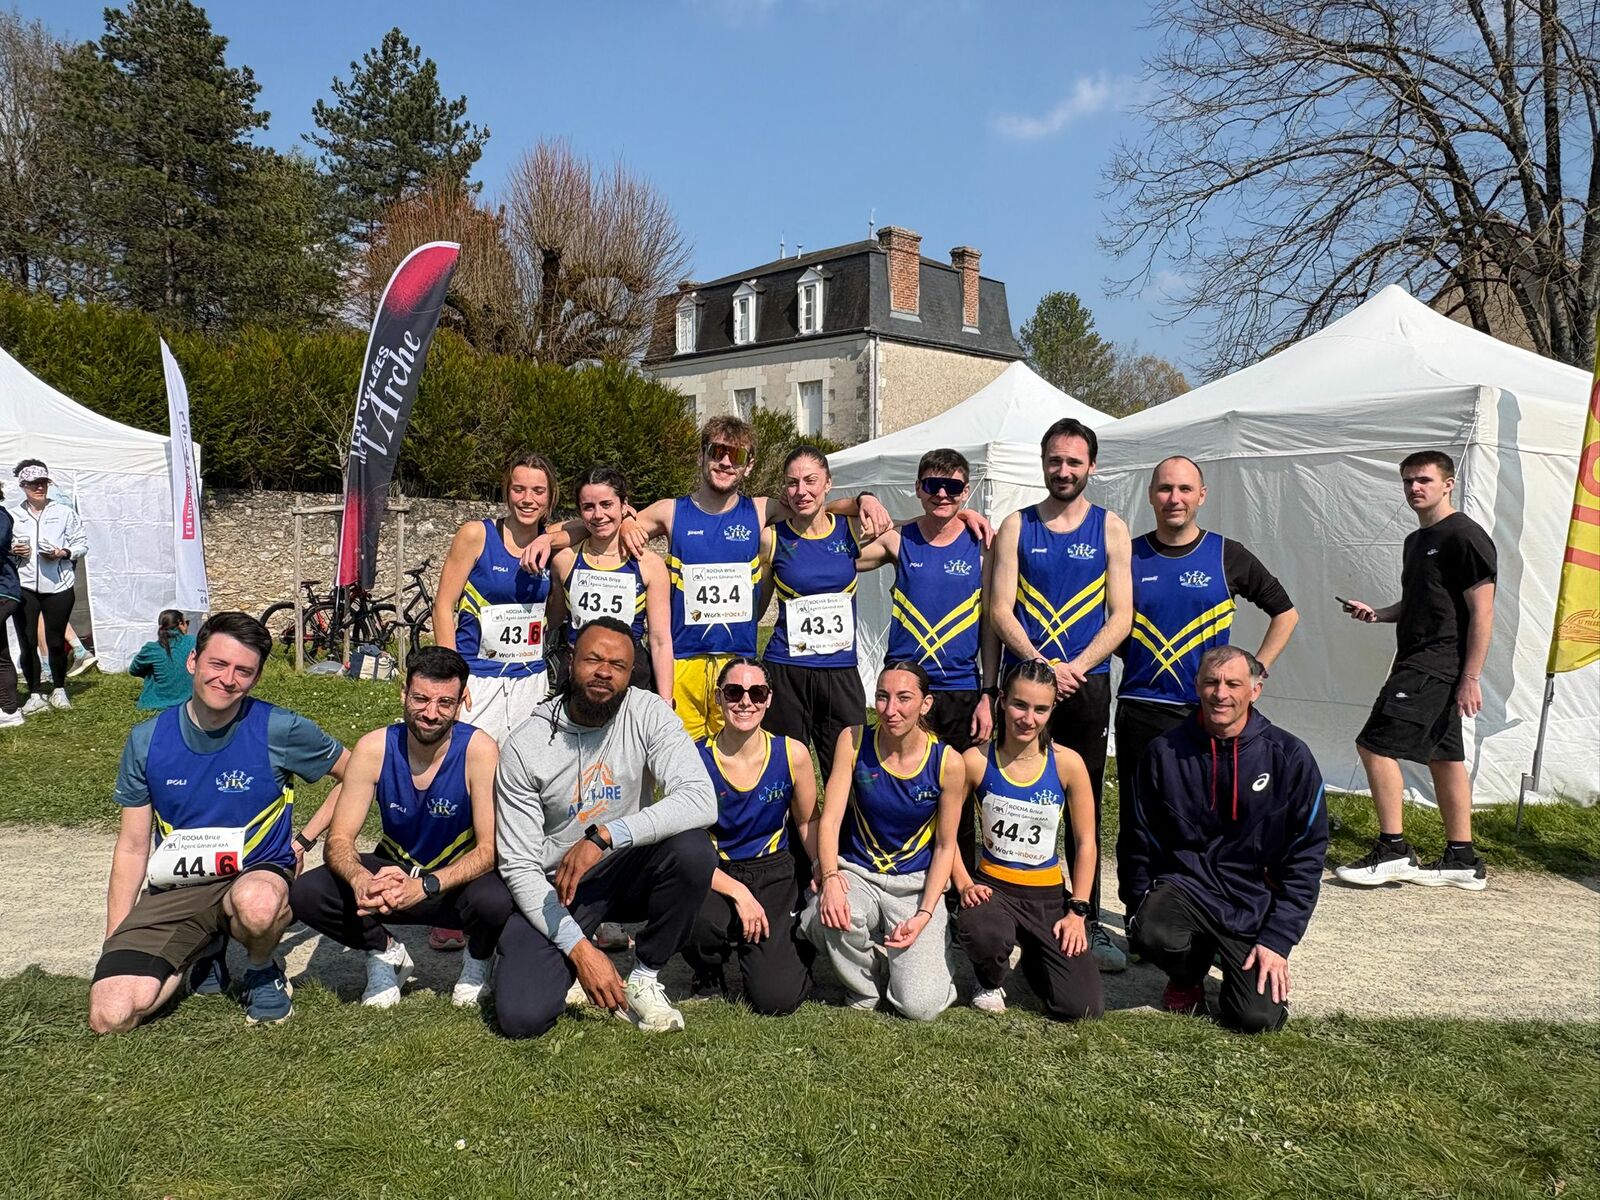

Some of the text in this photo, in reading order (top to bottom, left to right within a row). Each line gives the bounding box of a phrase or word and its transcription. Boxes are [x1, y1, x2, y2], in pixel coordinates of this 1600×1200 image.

[358, 345, 390, 421] OULÉES
[578, 592, 623, 614] 43.5
[696, 584, 740, 604] 43.4
[500, 625, 541, 644] 43.6
[800, 615, 843, 635] 43.3
[166, 779, 187, 787] POLI
[991, 819, 1042, 845] 44.3
[173, 855, 236, 878] 44.6
